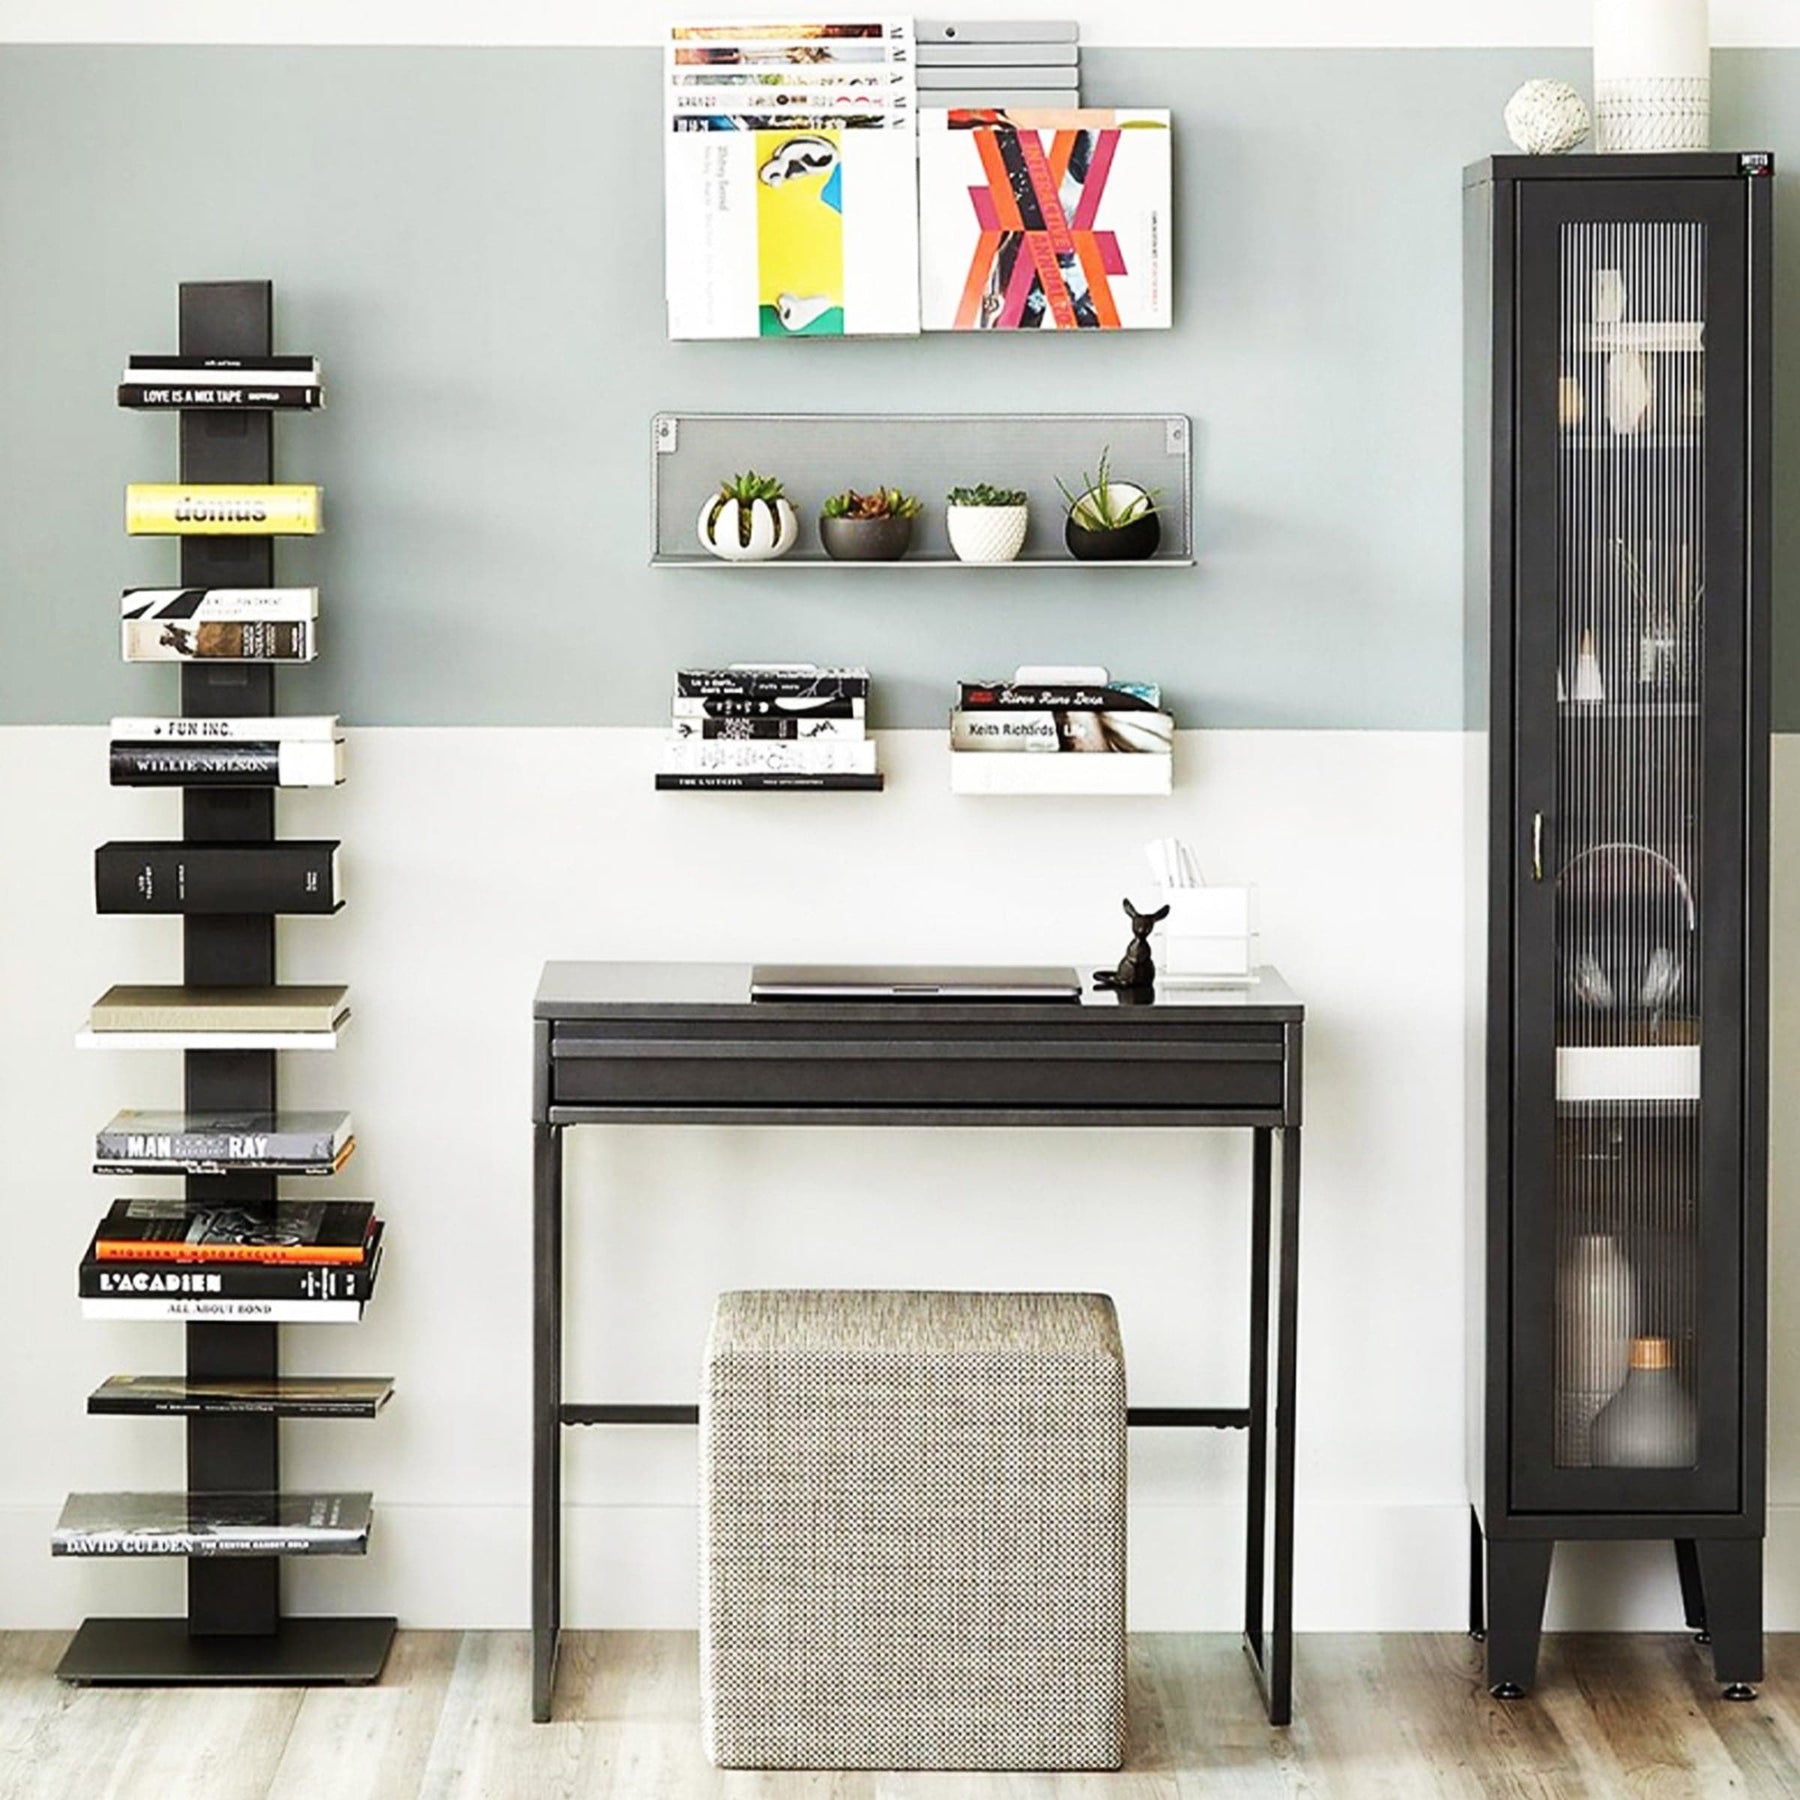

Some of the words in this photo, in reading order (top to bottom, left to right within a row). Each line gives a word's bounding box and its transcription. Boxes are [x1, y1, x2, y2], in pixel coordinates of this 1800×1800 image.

[143, 390, 170, 403] LOVE
[172, 390, 183, 403] IS
[185, 390, 193, 403] A
[194, 390, 214, 403] MIX
[216, 390, 242, 403] TAPE
[168, 722, 198, 736] FUN
[203, 722, 234, 736] INC.
[968, 723, 999, 736] Keith
[1002, 723, 1055, 736] Richards
[136, 759, 198, 772] WILLIE
[200, 759, 268, 772] NELSON
[127, 1136, 171, 1158] MAN
[229, 1136, 268, 1158] RAY
[100, 1272, 222, 1292] L'ACADIEN
[168, 1304, 190, 1314] ALL
[193, 1304, 233, 1314] ABOUT
[238, 1304, 272, 1314] BOND
[66, 1537, 118, 1553] DAVID
